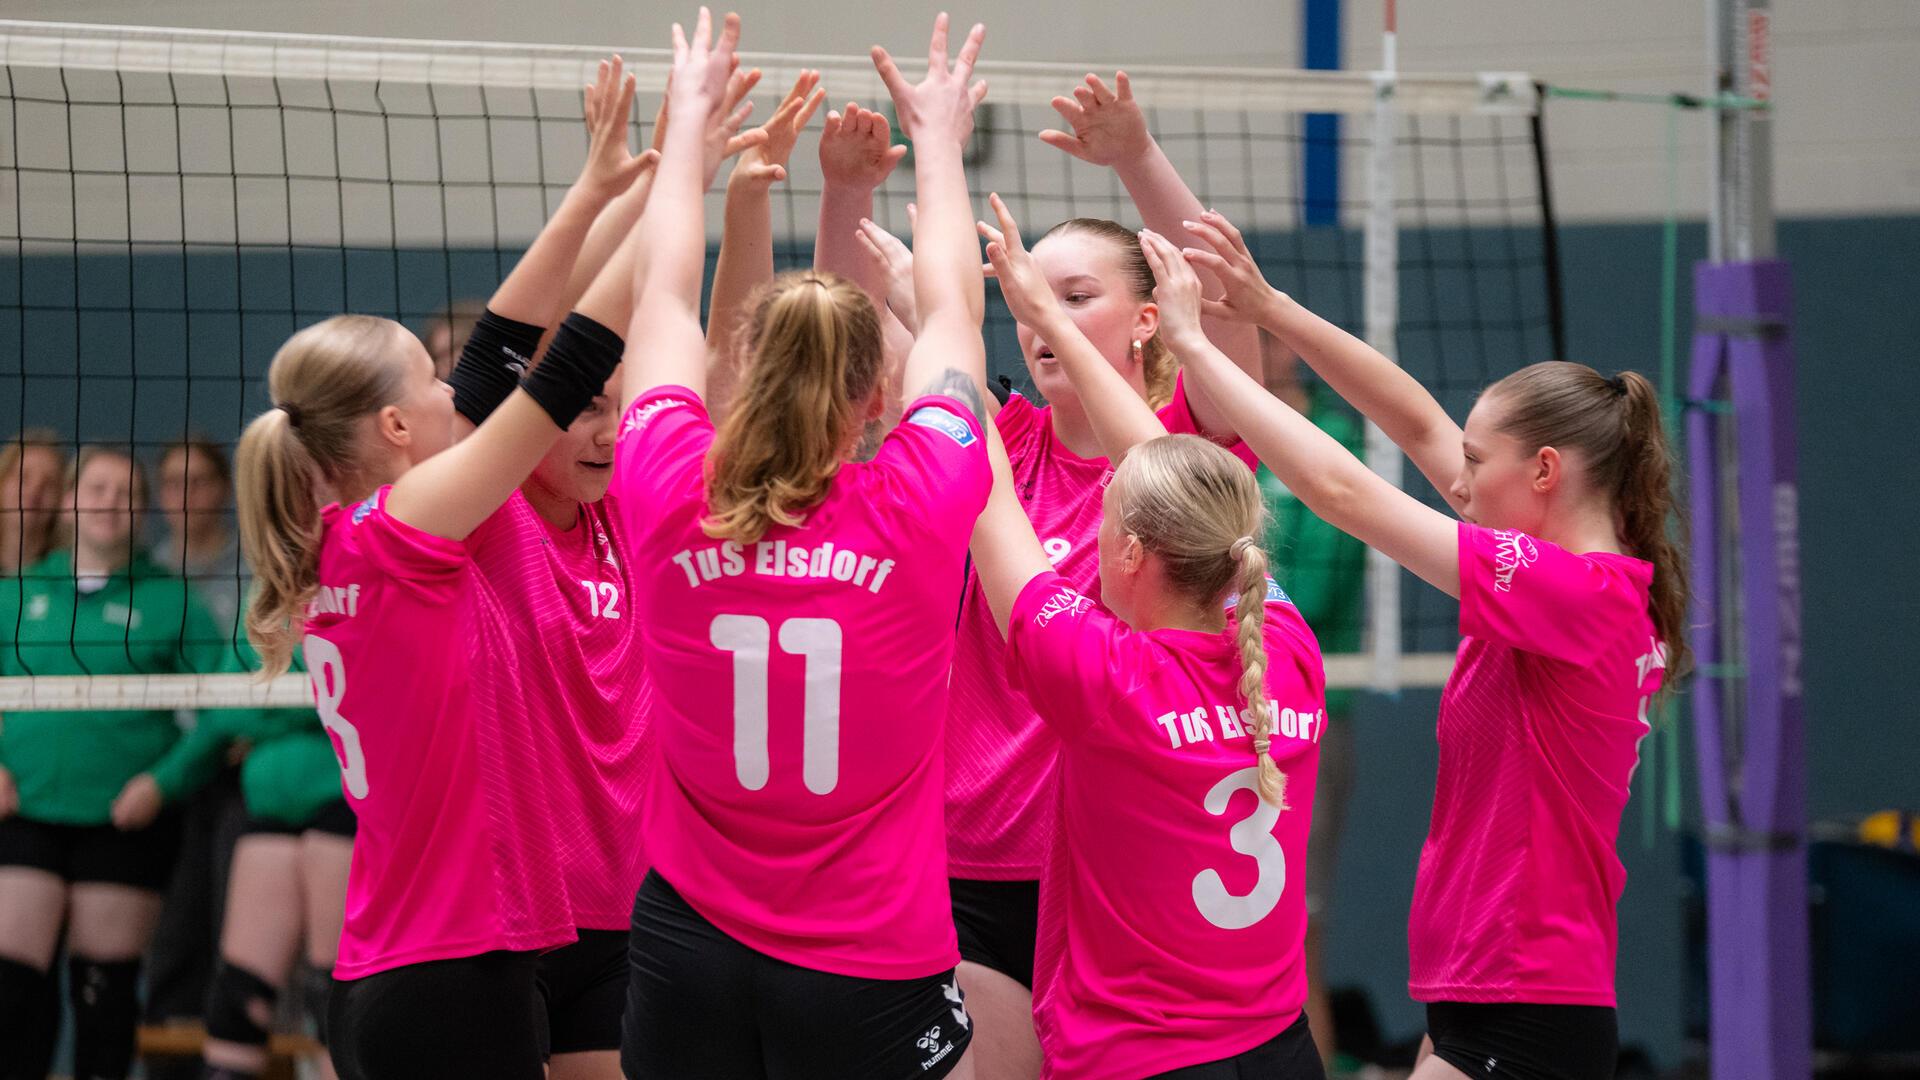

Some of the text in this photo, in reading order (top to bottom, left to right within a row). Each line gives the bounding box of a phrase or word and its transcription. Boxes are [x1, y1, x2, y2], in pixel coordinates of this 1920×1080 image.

[671, 539, 896, 595] TuS Elsdorf
[1043, 537, 1072, 566] 9
[1493, 529, 1514, 593] HWARZ
[581, 580, 621, 620] 12
[1033, 587, 1079, 628] WARZ
[303, 633, 370, 800] 8
[709, 613, 843, 796] 11
[1156, 705, 1215, 750] TuS
[1191, 766, 1287, 930] 3
[921, 1040, 954, 1071] hummel
